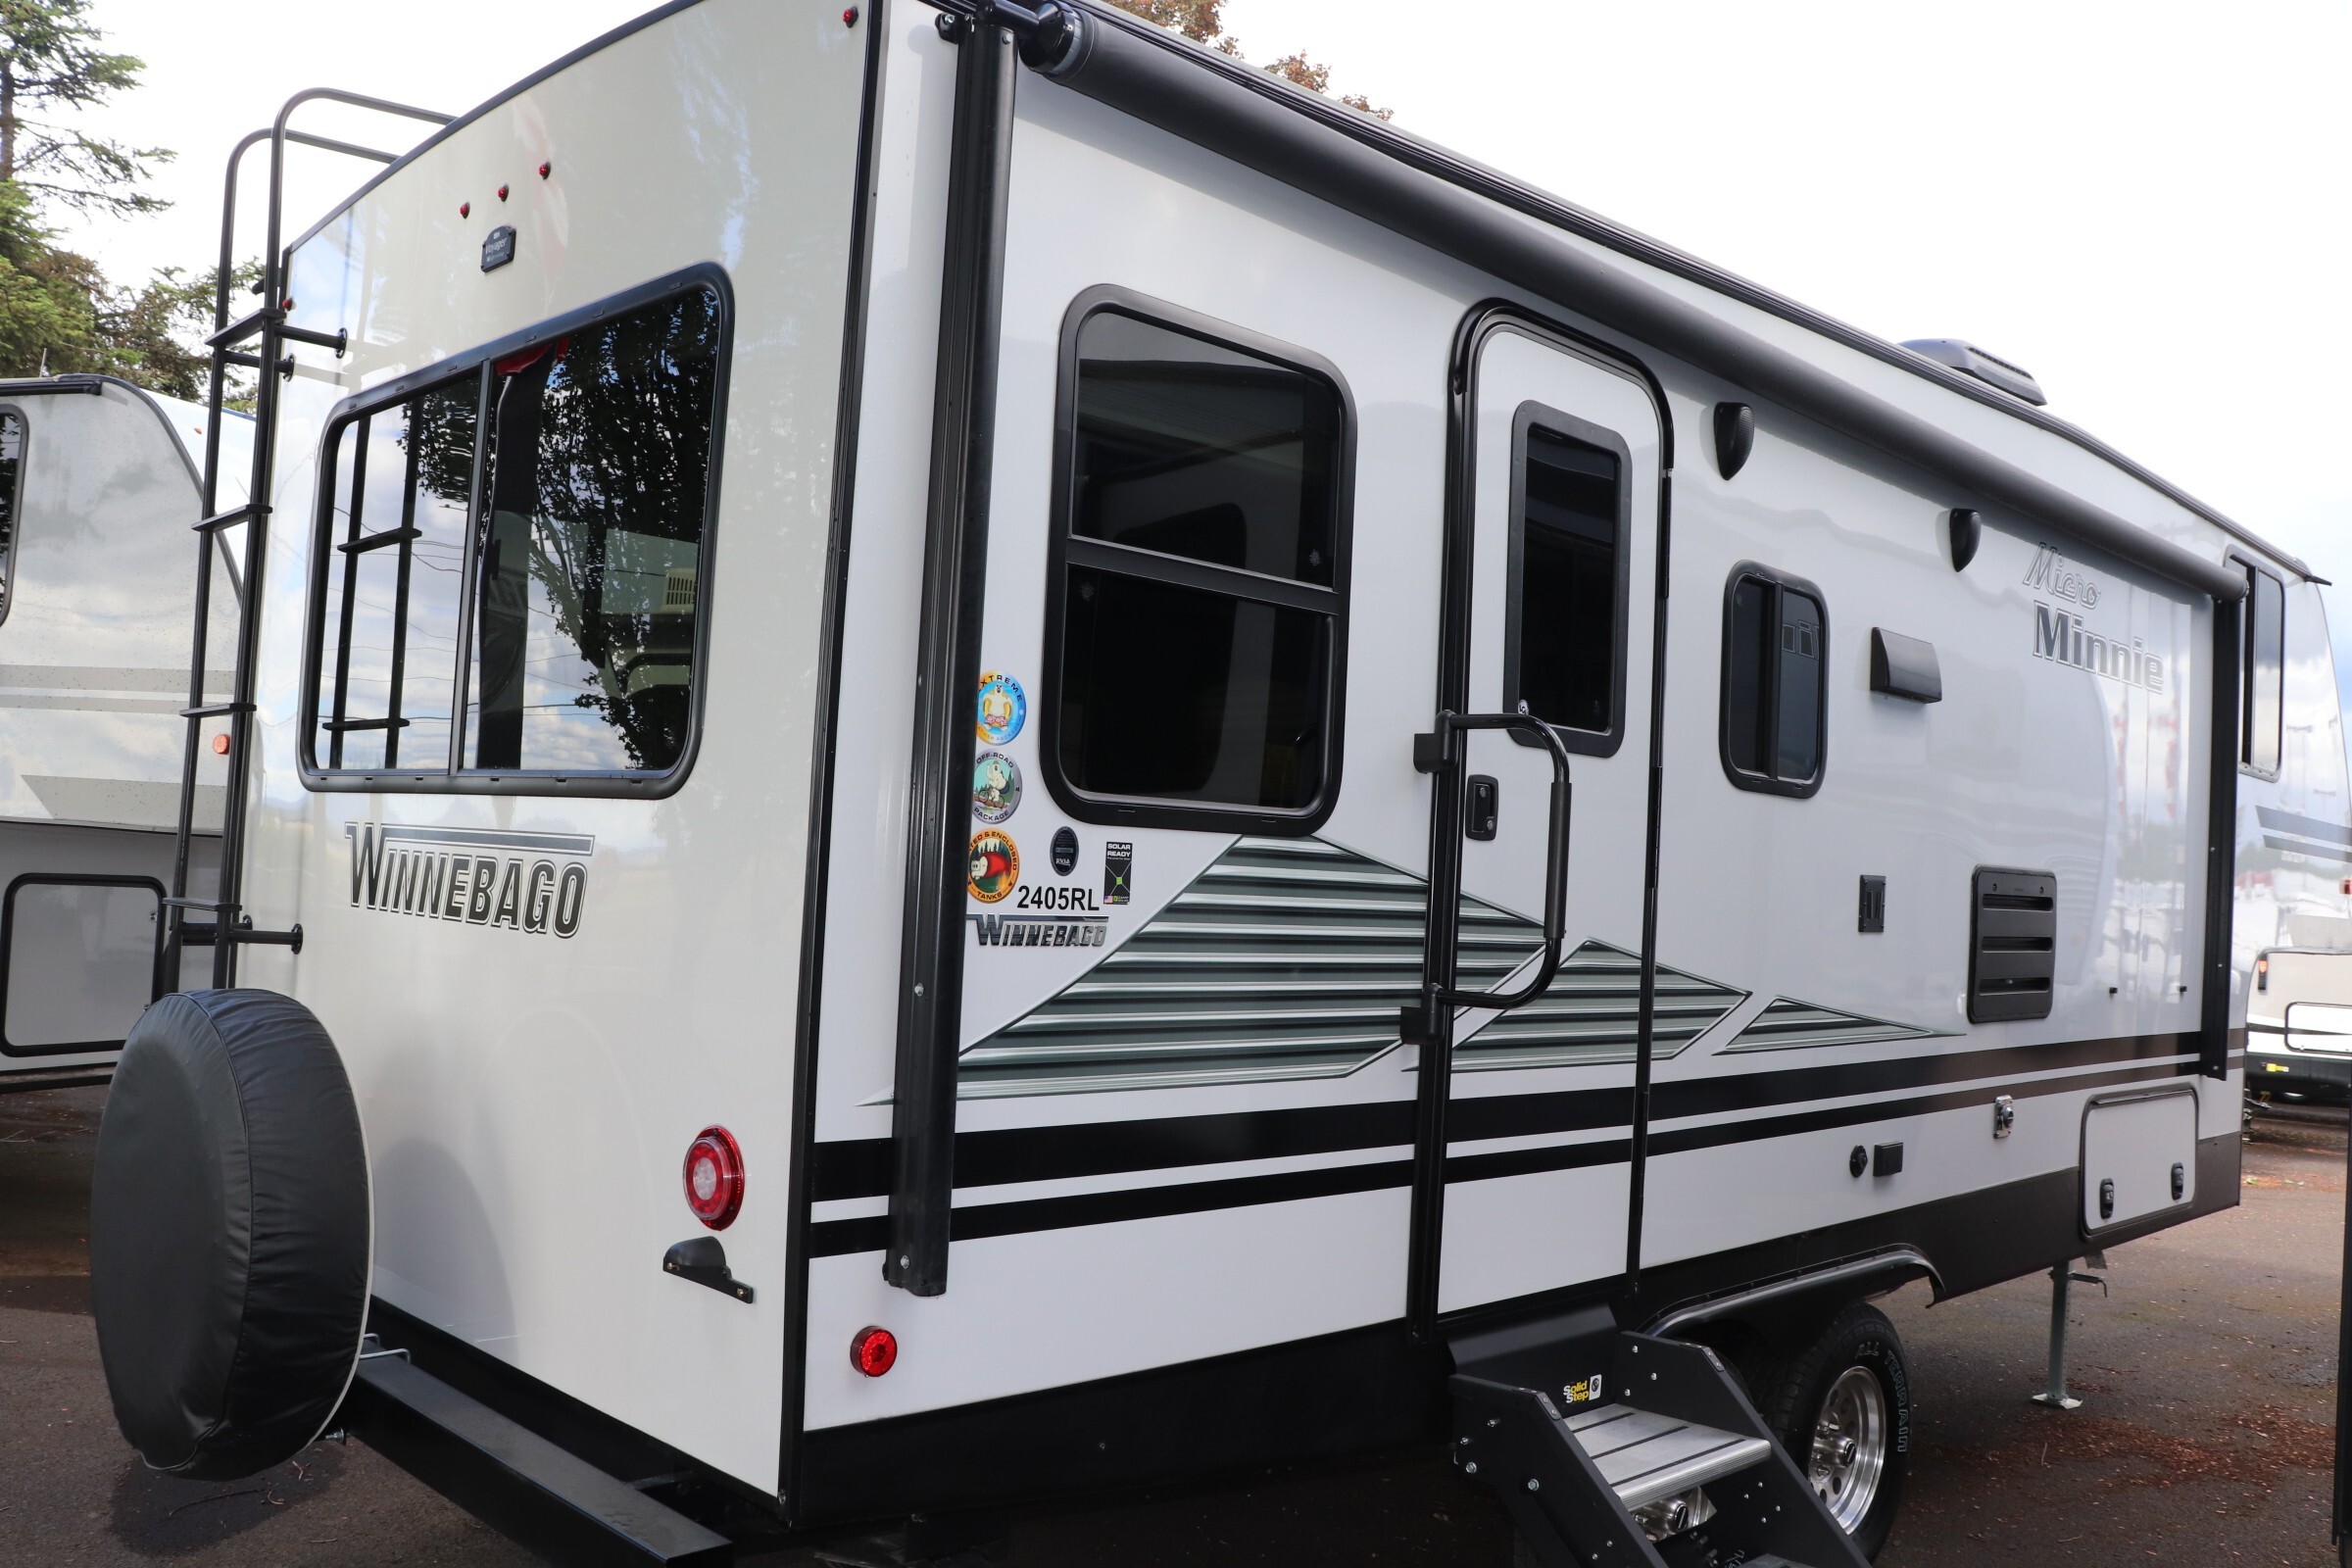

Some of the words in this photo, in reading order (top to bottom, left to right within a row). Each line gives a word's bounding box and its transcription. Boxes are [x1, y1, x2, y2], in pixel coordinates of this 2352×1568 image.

[2022, 541, 2101, 610] Micro
[2033, 599, 2164, 695] Minnie
[979, 673, 1023, 703] XTREME
[976, 752, 1014, 768] OFF-ROAD
[974, 807, 1009, 821] PACKAGE
[991, 831, 1017, 871] ENCLOSED
[344, 821, 596, 940] WINNEBAGO
[977, 891, 1003, 901] TANKS
[1016, 885, 1100, 911] 2405RL
[965, 912, 1109, 948] WINNEBAGO
[1563, 1380, 1588, 1396] Solid
[1566, 1391, 1590, 1404] Step
[1884, 1348, 1909, 1452] TERRAIN
